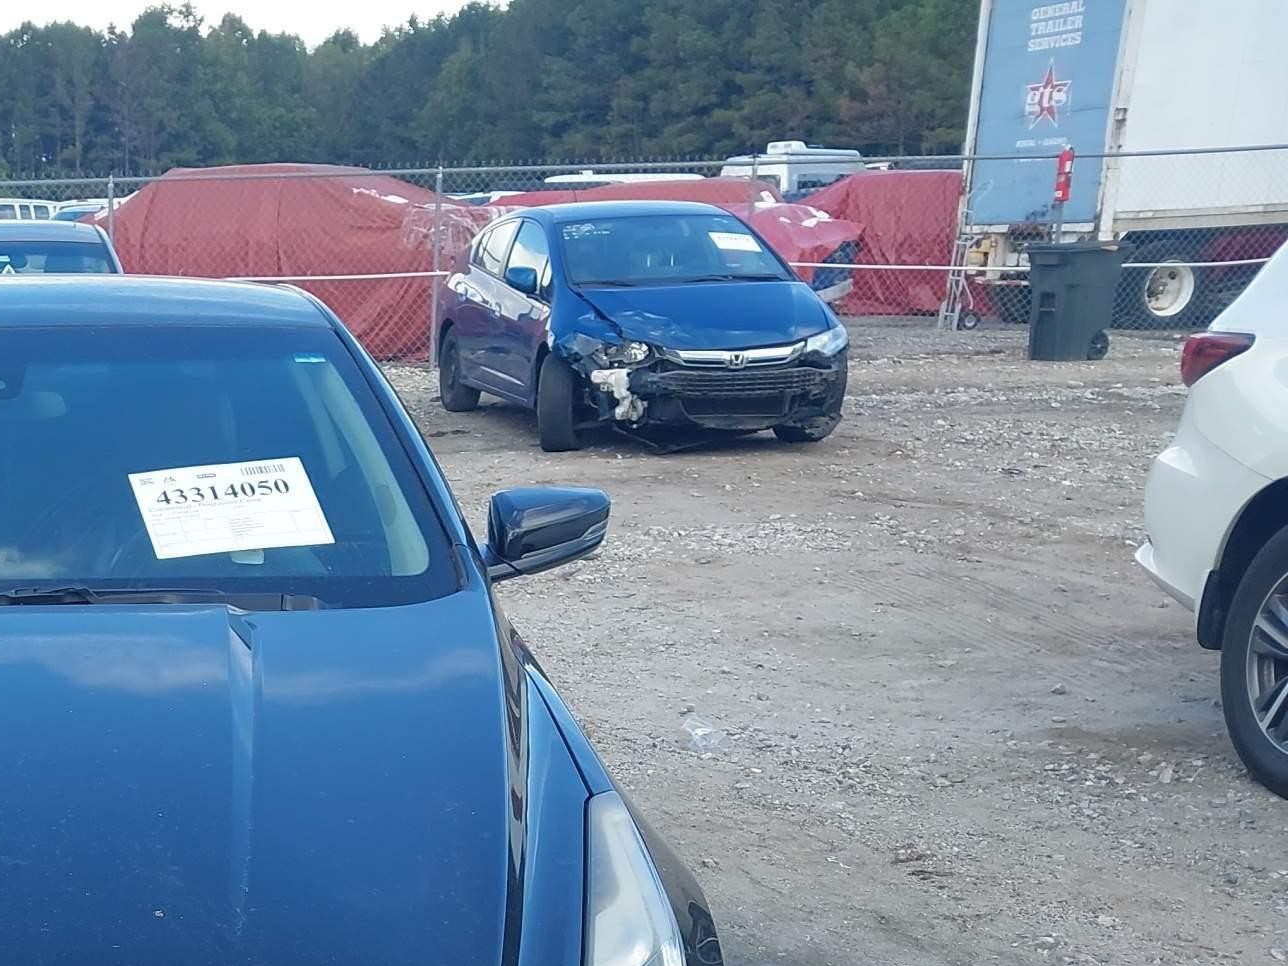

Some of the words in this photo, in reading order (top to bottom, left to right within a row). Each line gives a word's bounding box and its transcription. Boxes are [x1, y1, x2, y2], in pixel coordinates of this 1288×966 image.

[1031, 0, 1086, 19] GENERAL
[1030, 15, 1083, 35] TRAILER
[1027, 32, 1082, 51] SERVICES
[1025, 84, 1067, 117] gts
[157, 478, 290, 505] 43314050
